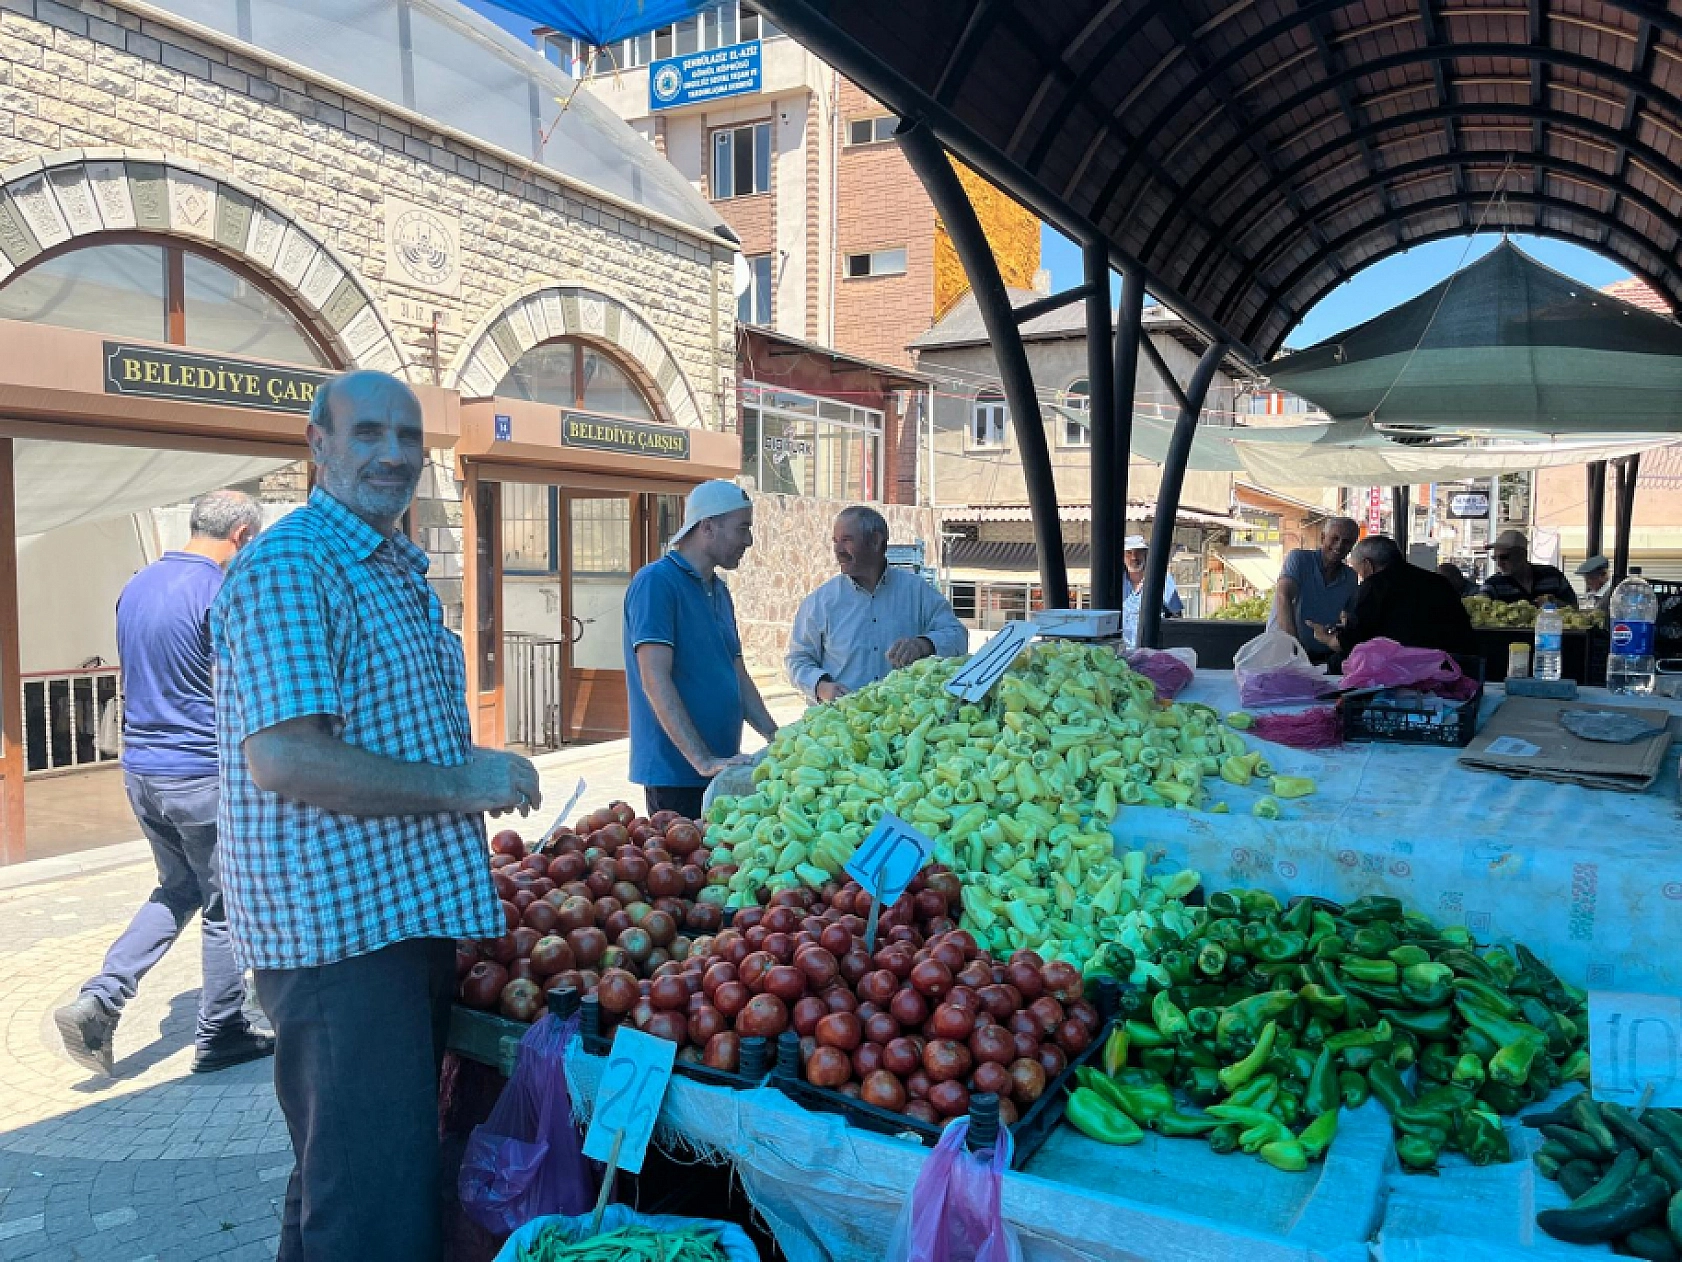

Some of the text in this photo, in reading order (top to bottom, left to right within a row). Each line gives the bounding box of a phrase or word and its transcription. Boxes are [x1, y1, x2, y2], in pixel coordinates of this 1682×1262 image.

[122, 358, 320, 404] BELEDİYE ÇAR
[569, 421, 685, 454] BELEDİYE ÇARŞISI
[849, 825, 925, 895] 10
[1600, 1012, 1678, 1094] 10
[597, 1056, 666, 1153] 25
